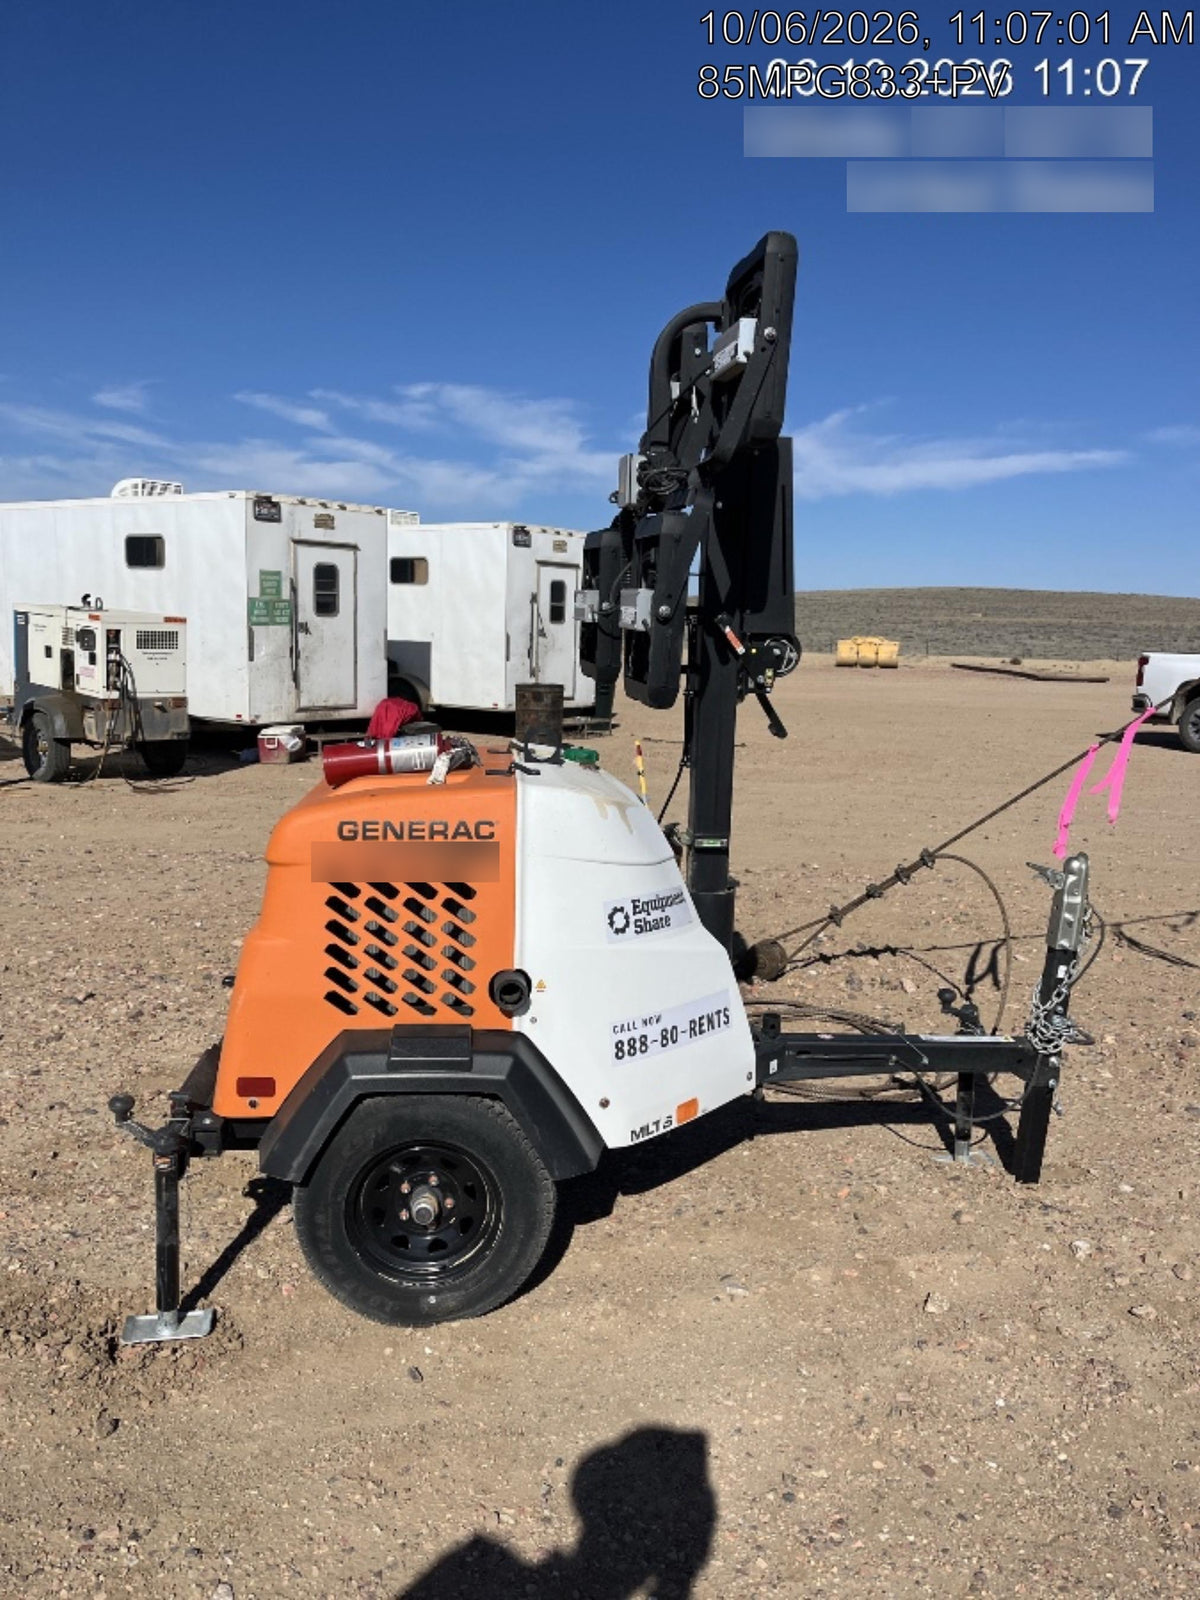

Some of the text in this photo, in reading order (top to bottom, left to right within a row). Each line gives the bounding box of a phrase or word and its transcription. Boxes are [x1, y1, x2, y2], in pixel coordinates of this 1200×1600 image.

[337, 820, 496, 842] GENERAC
[633, 915, 671, 935] Share
[612, 1013, 662, 1035] CALL NOW
[614, 1006, 730, 1061] 888-80-RENTS
